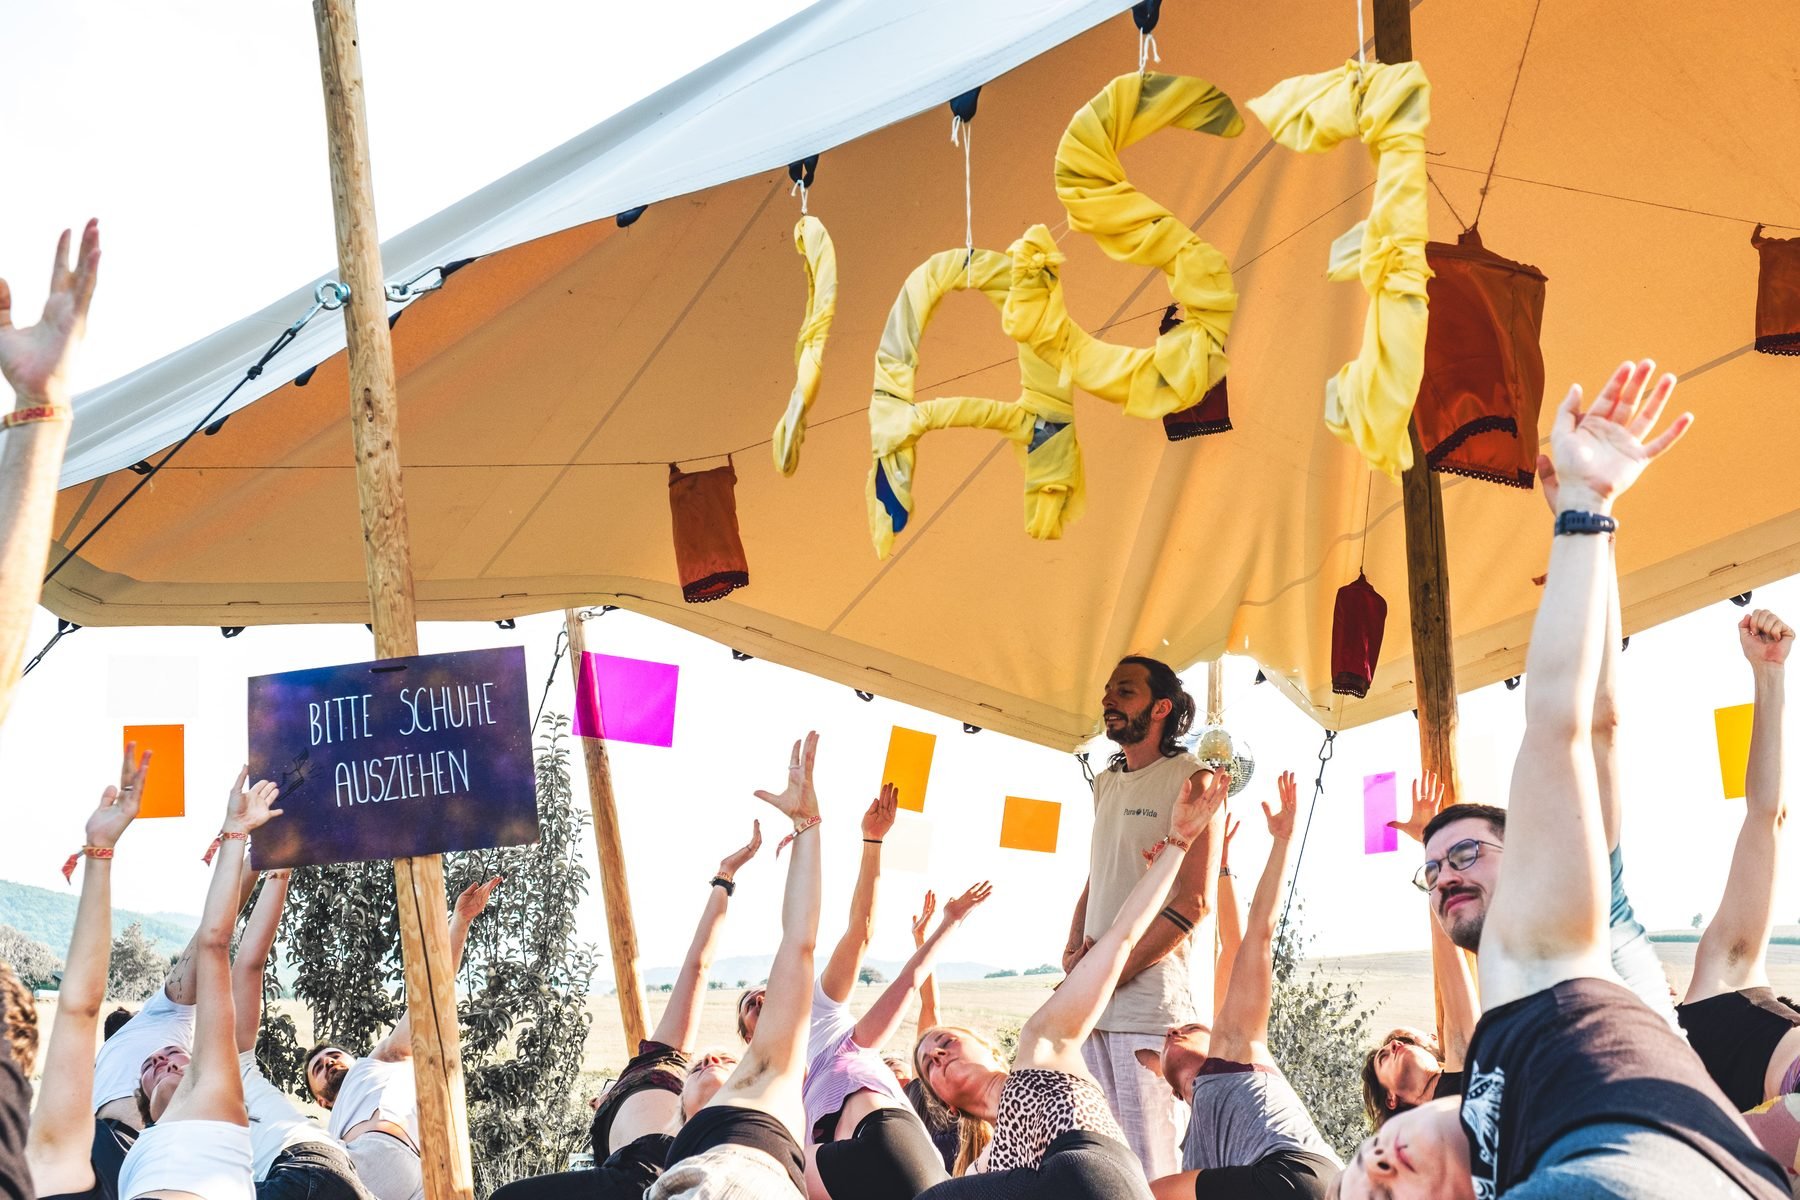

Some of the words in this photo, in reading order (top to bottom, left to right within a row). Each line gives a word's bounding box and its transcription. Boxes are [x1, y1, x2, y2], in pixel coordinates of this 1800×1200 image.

[308, 694, 373, 746] BITTE
[398, 682, 497, 736] SCHUHE
[334, 748, 470, 808] AUSZIEHEN
